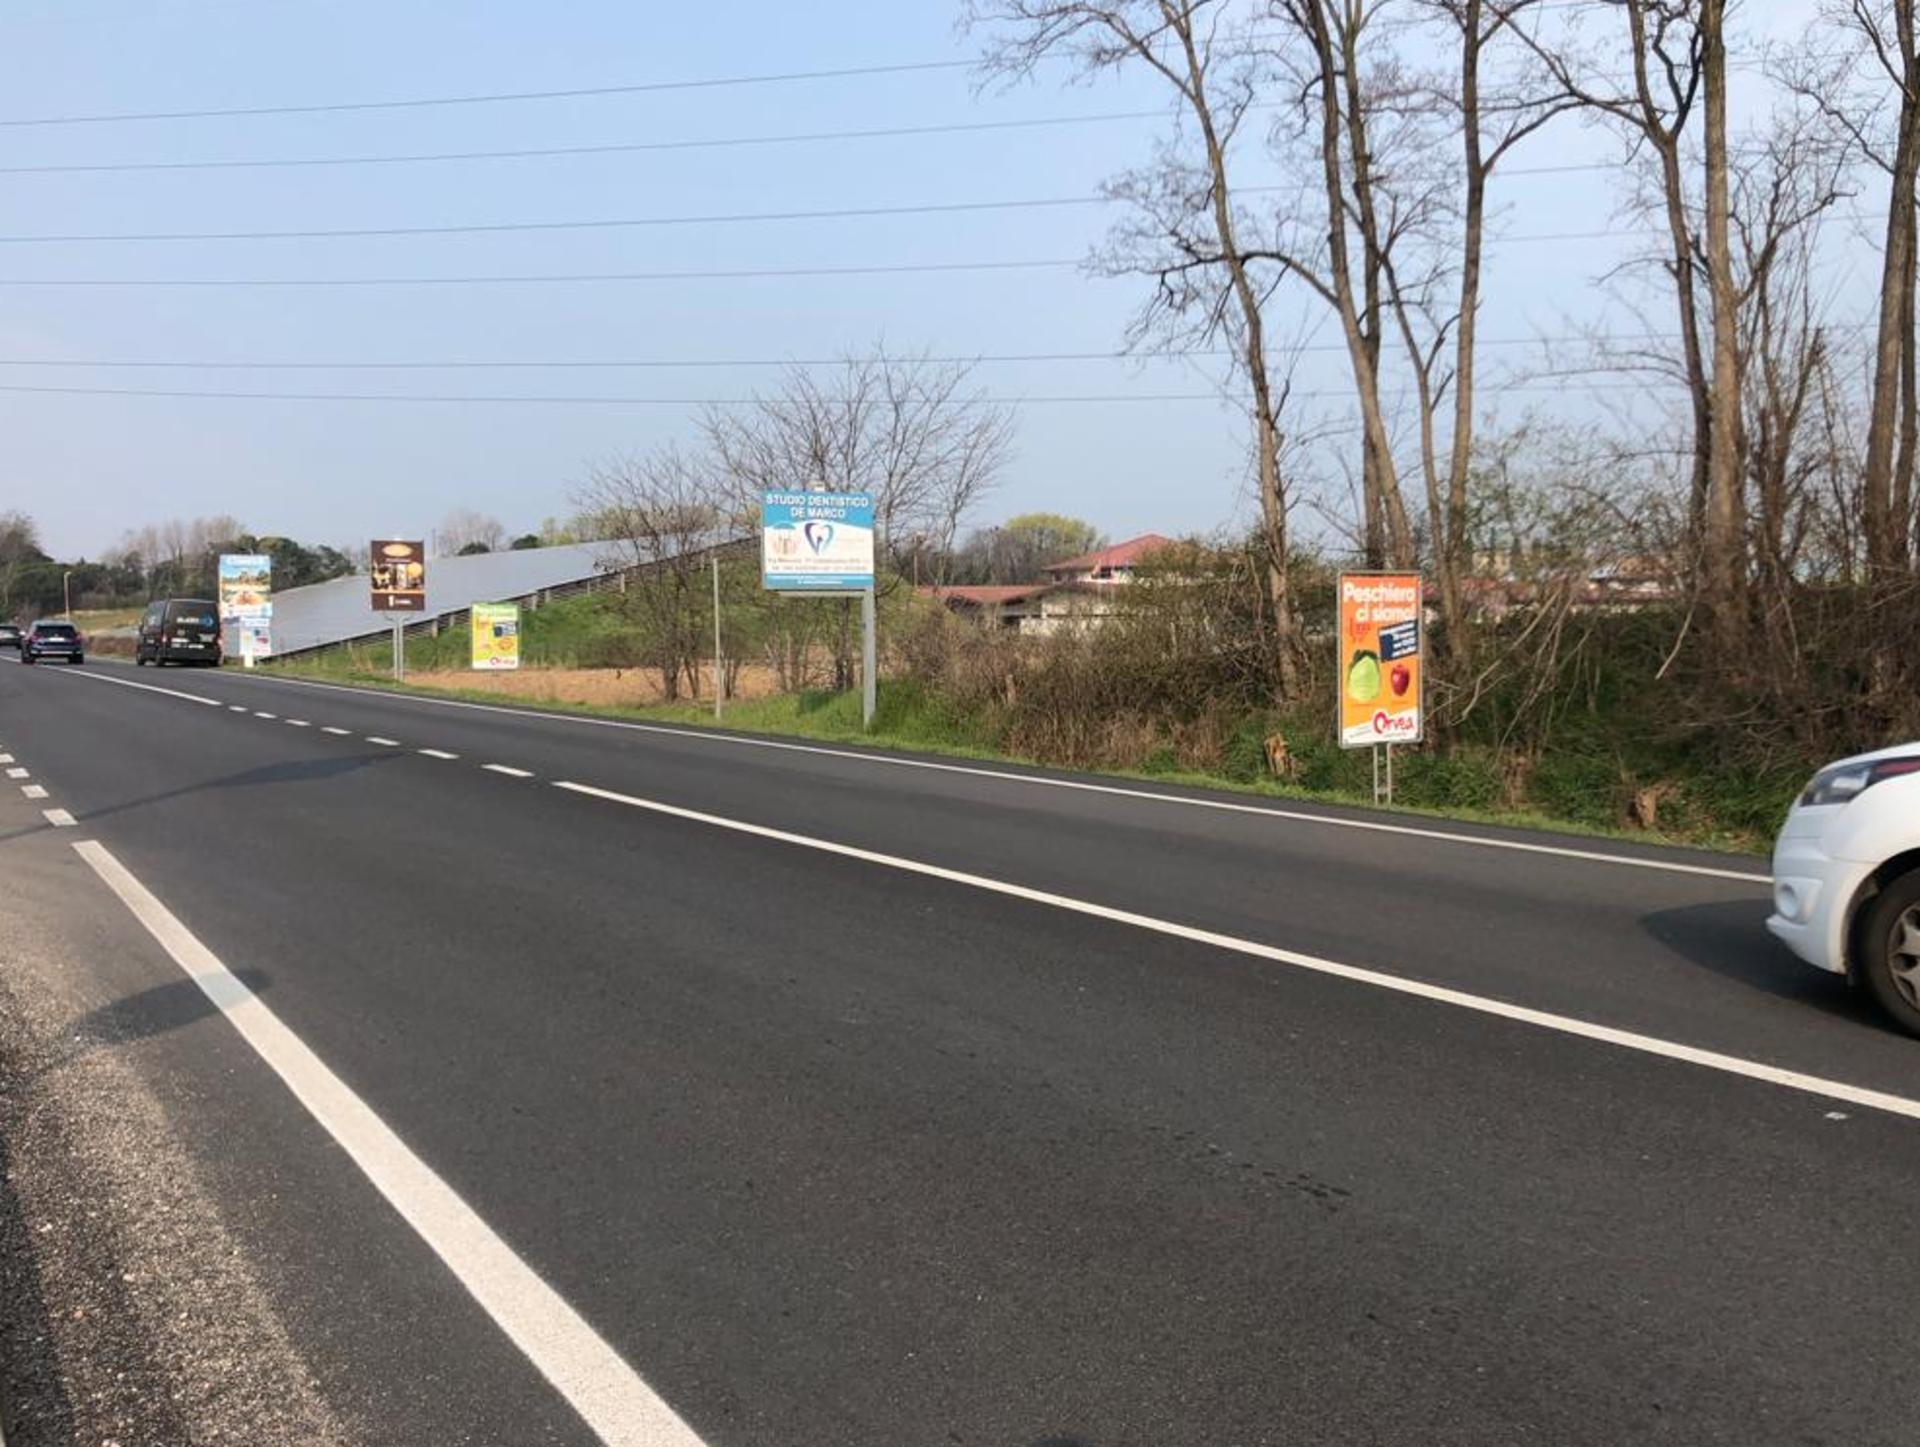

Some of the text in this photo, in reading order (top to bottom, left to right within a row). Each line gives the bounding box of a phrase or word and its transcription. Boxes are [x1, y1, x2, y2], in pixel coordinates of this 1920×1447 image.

[766, 494, 868, 507] STUDIO DENTISTICO
[790, 507, 845, 518] DE MARCO
